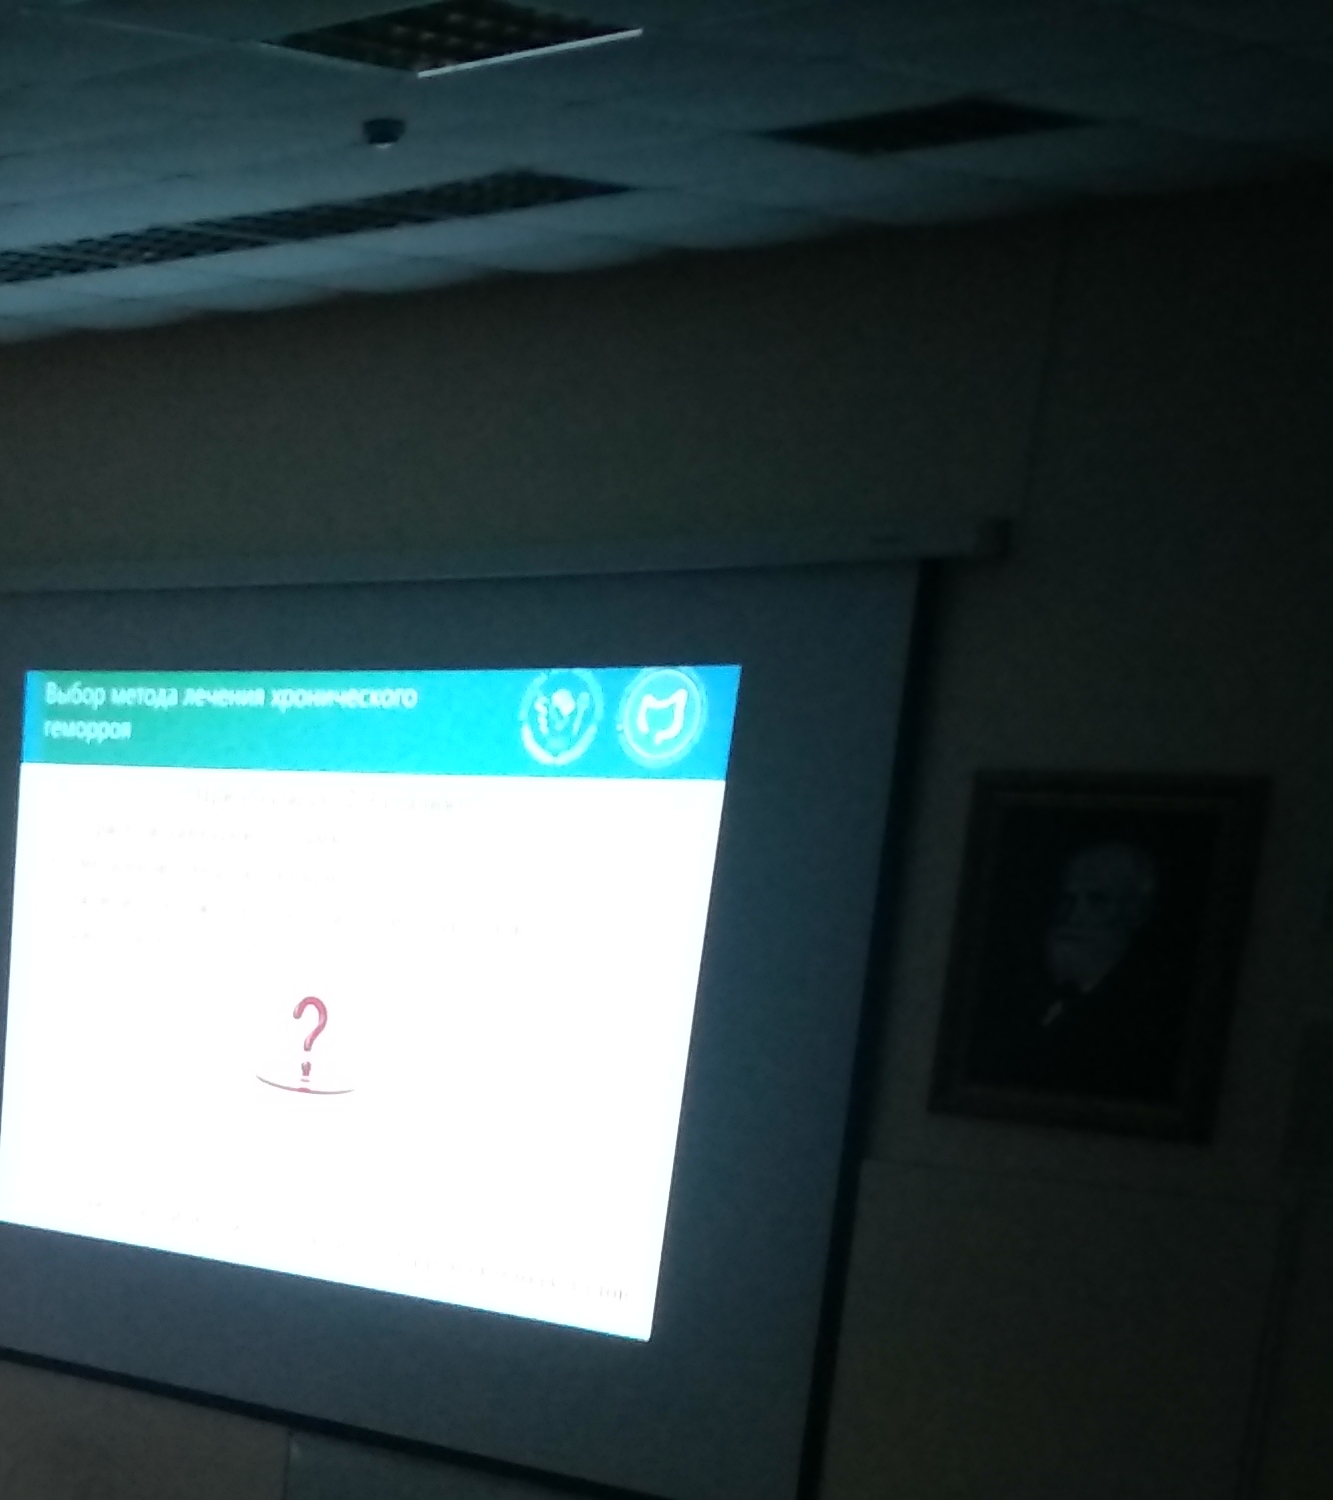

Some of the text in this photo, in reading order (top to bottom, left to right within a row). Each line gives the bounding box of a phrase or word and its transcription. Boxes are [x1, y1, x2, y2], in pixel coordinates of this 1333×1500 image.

[46, 682, 418, 713] Выбор метода лечения хронического
[44, 721, 131, 744] геморроя
